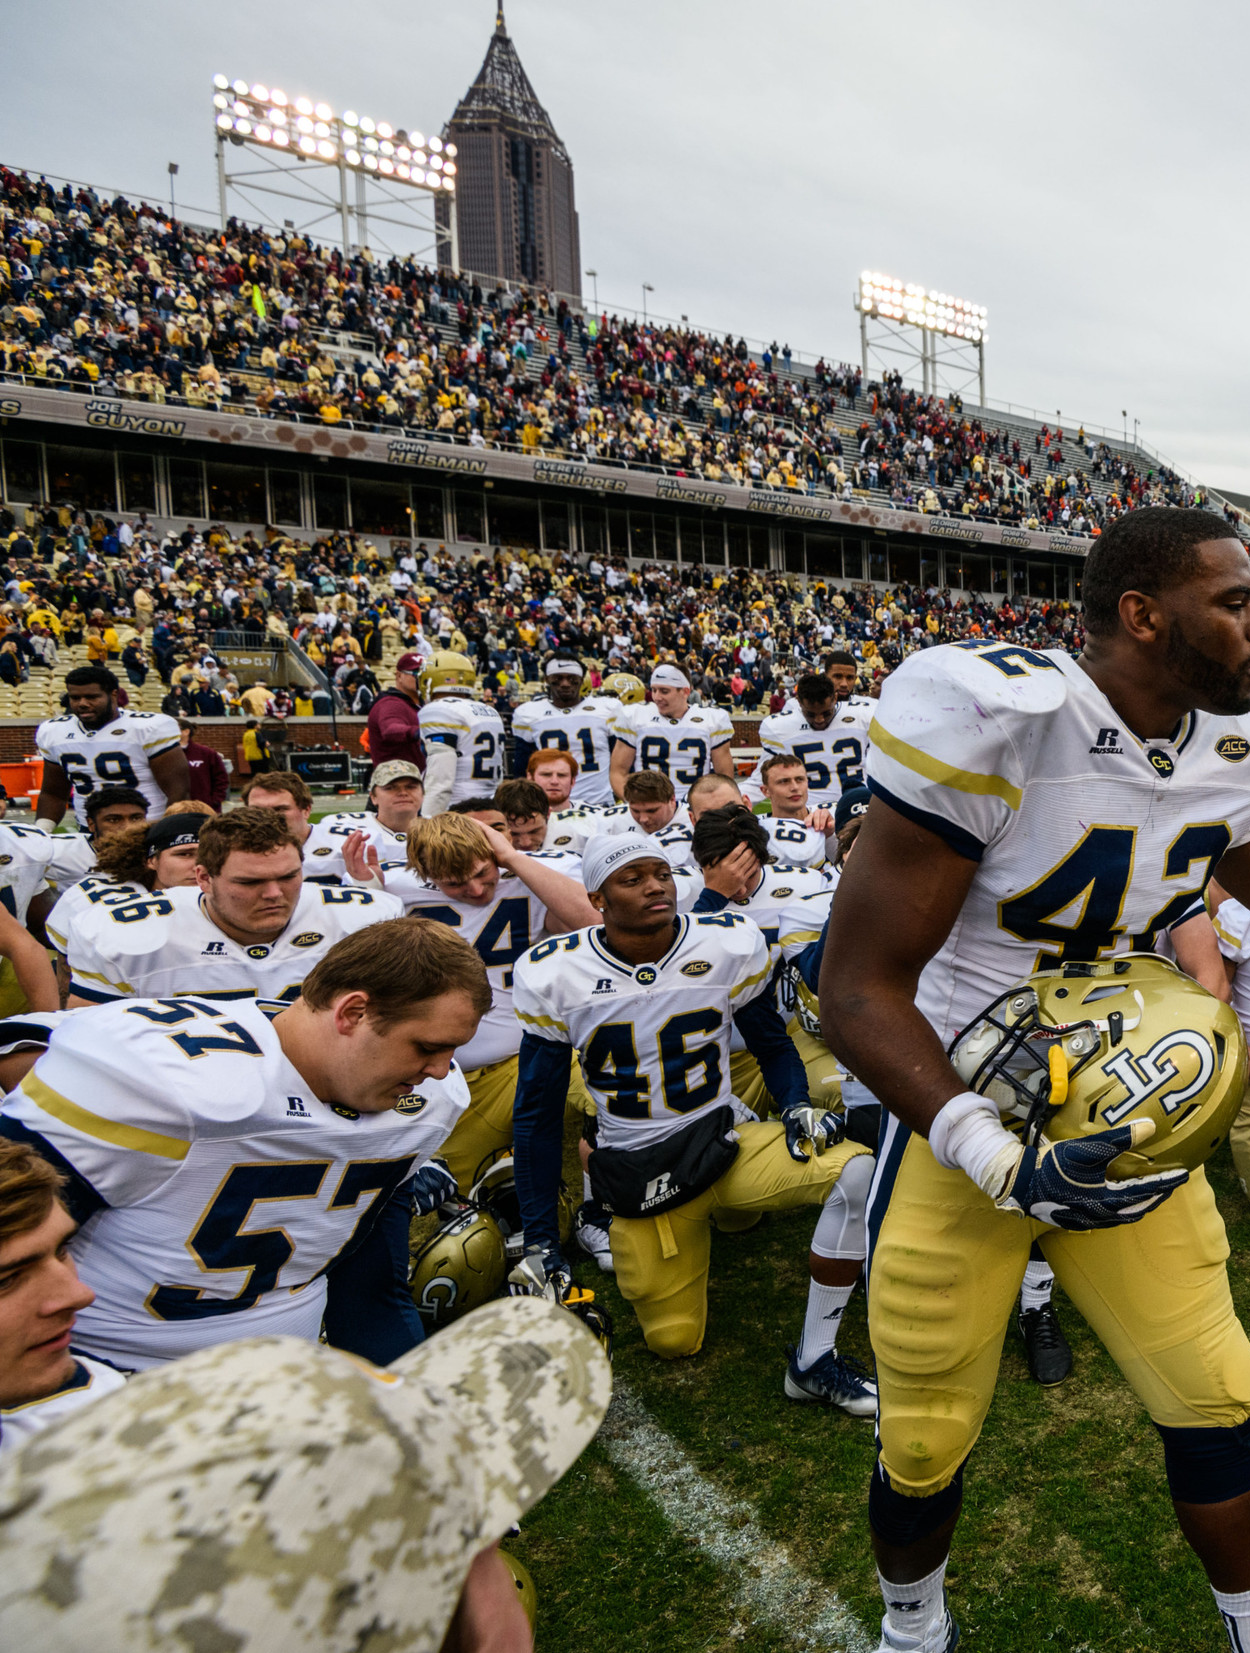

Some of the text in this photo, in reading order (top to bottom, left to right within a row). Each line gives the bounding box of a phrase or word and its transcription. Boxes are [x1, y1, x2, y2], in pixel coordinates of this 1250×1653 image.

[86, 401, 122, 414] JOE
[87, 412, 186, 437] GUYON
[388, 440, 429, 454] JOHN
[388, 450, 487, 474] HEISMAN
[534, 460, 588, 475] EVERETT
[533, 469, 628, 492] STRUPPER
[657, 478, 679, 489] BILL
[656, 486, 727, 505] FINCHER
[750, 491, 790, 504] WILLIAM
[748, 499, 832, 521] ALEXANDER
[929, 518, 961, 529] GEORGE
[929, 526, 983, 542] GARDNER
[1001, 528, 1027, 538] BOBBY
[1000, 535, 1031, 547] DODD
[1049, 542, 1087, 554] MORRIS
[613, 678, 637, 689] GT
[1089, 746, 1124, 755] RUSSELL
[1220, 740, 1247, 752] ACC
[640, 736, 707, 785] 83
[792, 737, 865, 791] 52
[1150, 755, 1171, 772] GT
[60, 751, 140, 795] 69
[997, 820, 1232, 973] 42
[298, 935, 320, 943] ACC
[685, 963, 708, 972] ACC
[584, 1006, 724, 1120] 46
[1100, 1029, 1216, 1128] GT
[396, 1096, 422, 1107] ACC
[286, 1110, 312, 1118] RUSSELL
[640, 1184, 681, 1212] RUSSELL
[143, 1153, 420, 1322] 57
